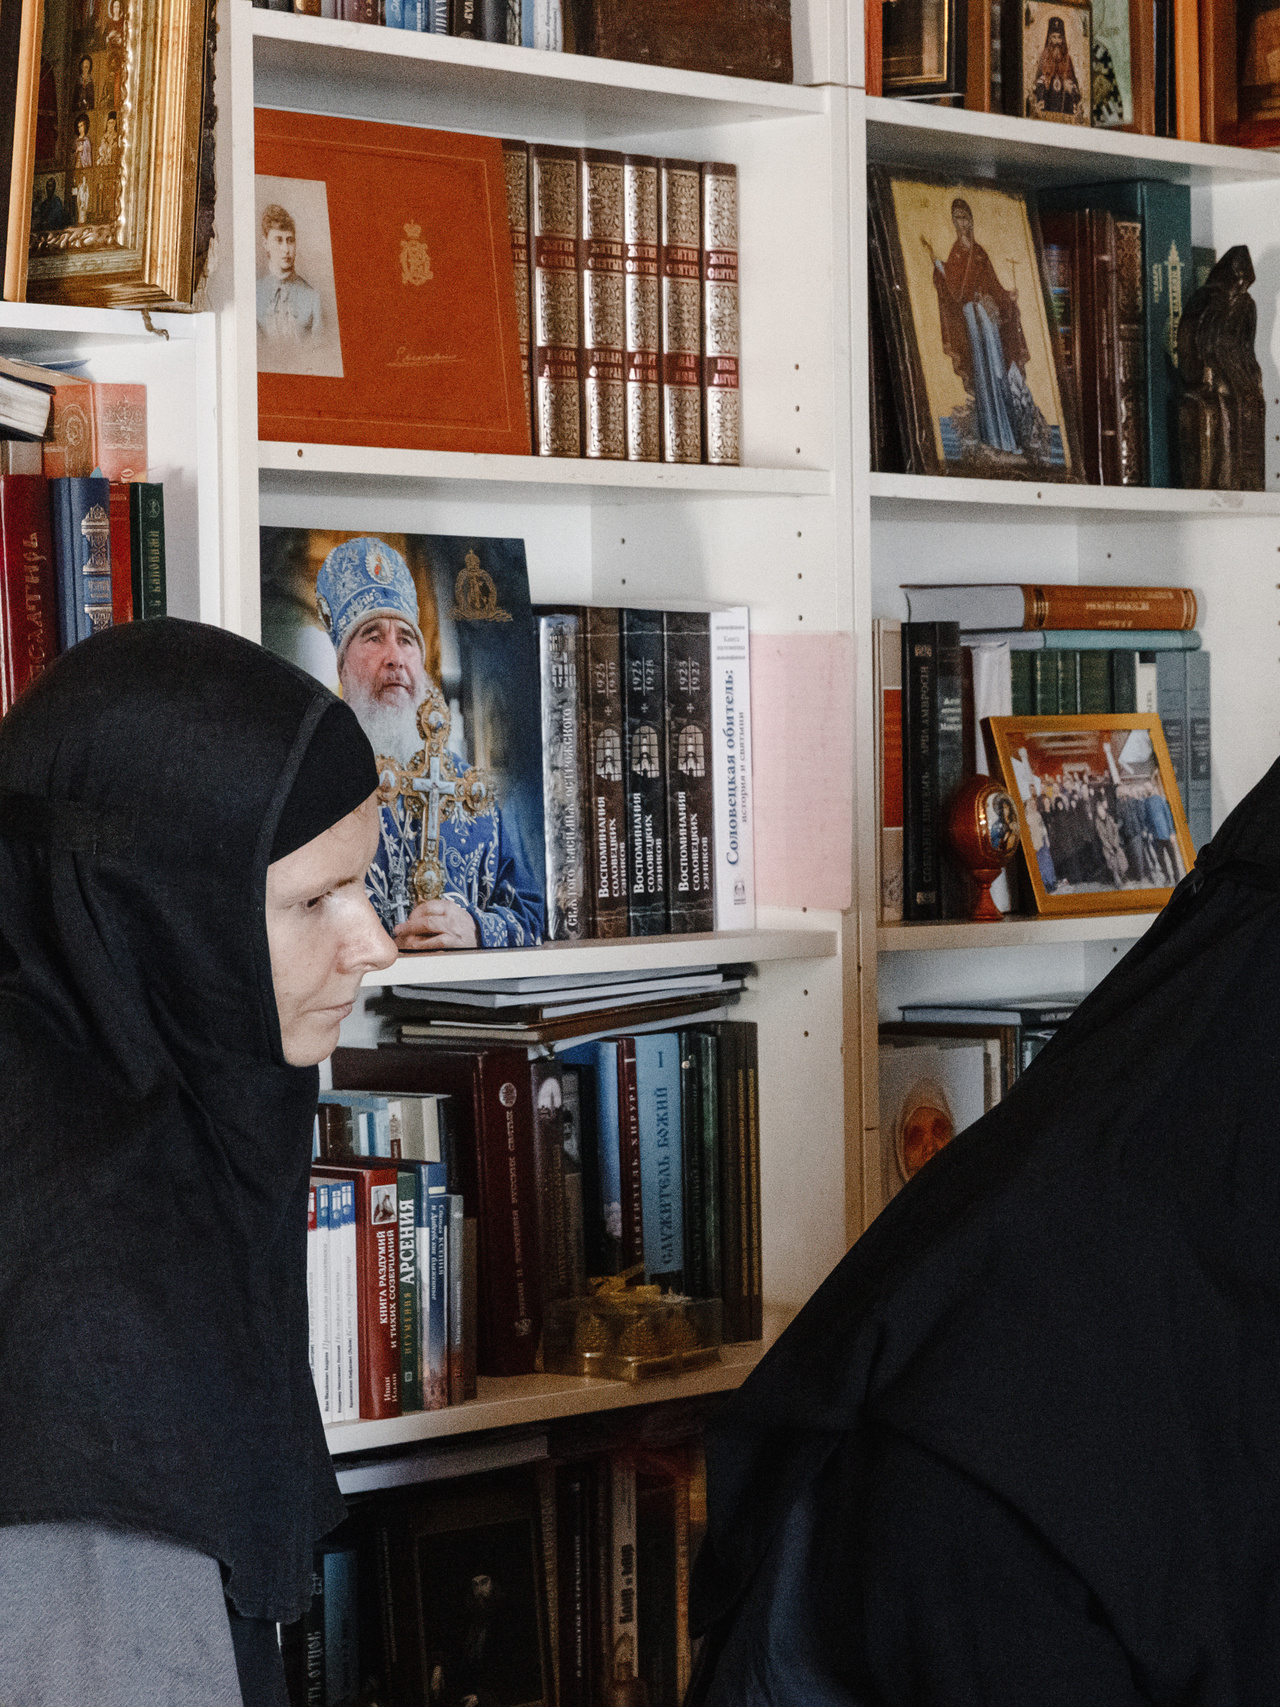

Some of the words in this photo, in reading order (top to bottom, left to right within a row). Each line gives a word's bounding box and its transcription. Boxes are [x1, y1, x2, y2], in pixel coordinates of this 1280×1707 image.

[723, 669, 736, 749] обитель:
[725, 753, 739, 866] Соловецкая
[652, 1087, 669, 1148] БОЖИЙ
[399, 1199, 415, 1285] АРСЕНИЯ
[655, 1157, 674, 1265] СЛУЖИТЕЛЬ
[376, 1230, 388, 1287] РАЗДУМИЙ
[386, 1230, 397, 1300] СОЗЕРЦАНИЙ
[378, 1289, 388, 1324] КНИГА
[388, 1302, 397, 1338] ТИХИХ
[383, 1376, 392, 1402] Иван
